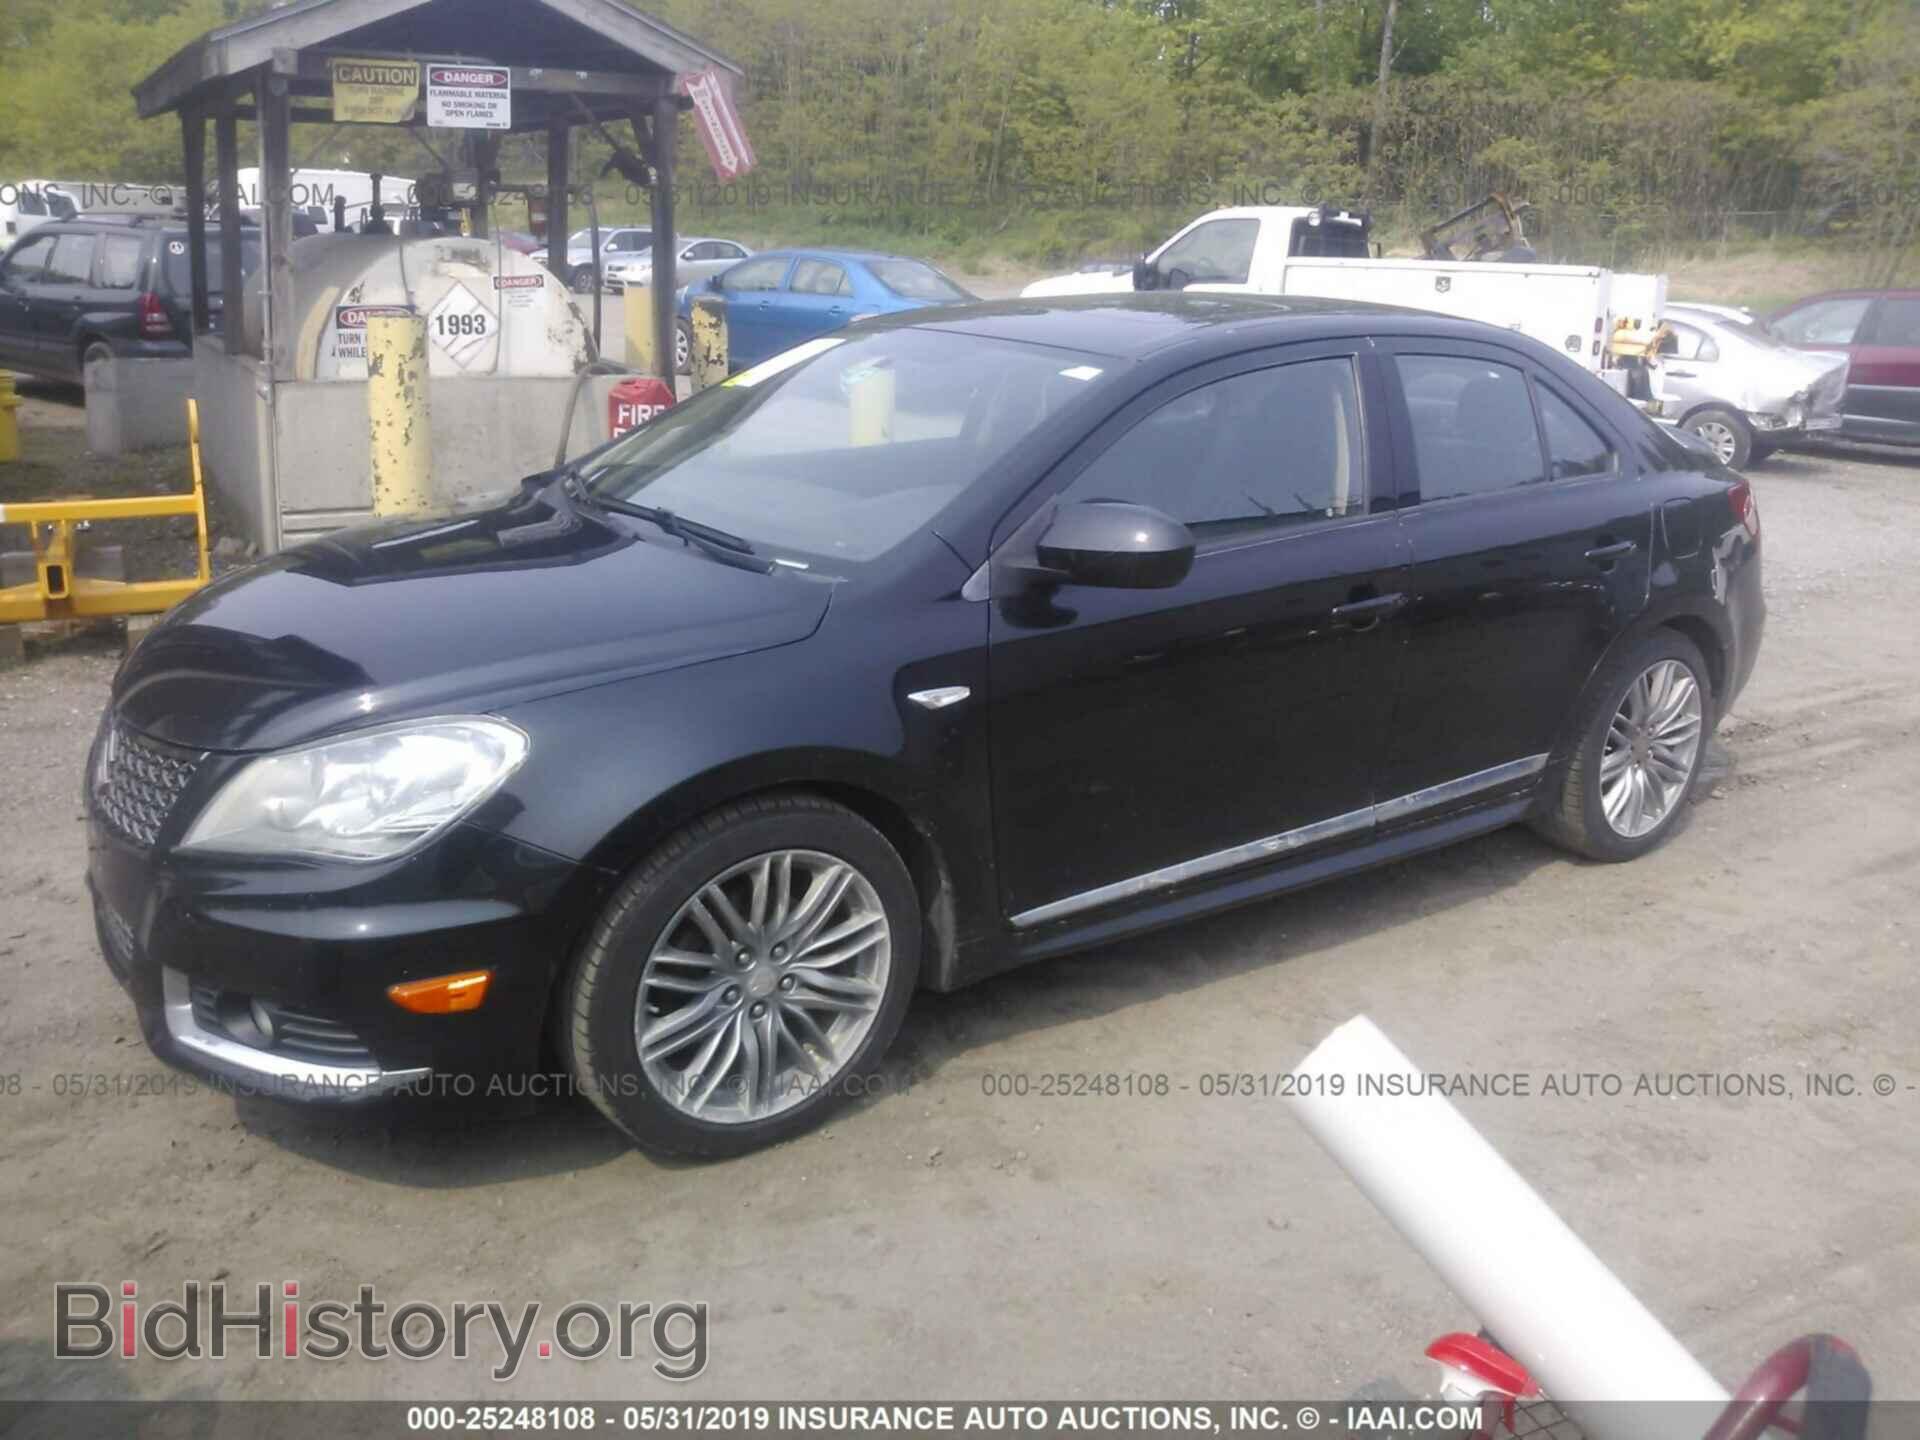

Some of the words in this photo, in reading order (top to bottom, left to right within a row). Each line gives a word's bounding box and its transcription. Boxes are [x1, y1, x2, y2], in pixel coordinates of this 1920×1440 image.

[338, 66, 415, 85] CAUTION
[443, 71, 494, 85] DANGER
[435, 314, 487, 336] 1993
[338, 333, 361, 345] TURN
[338, 347, 367, 358] WHILE
